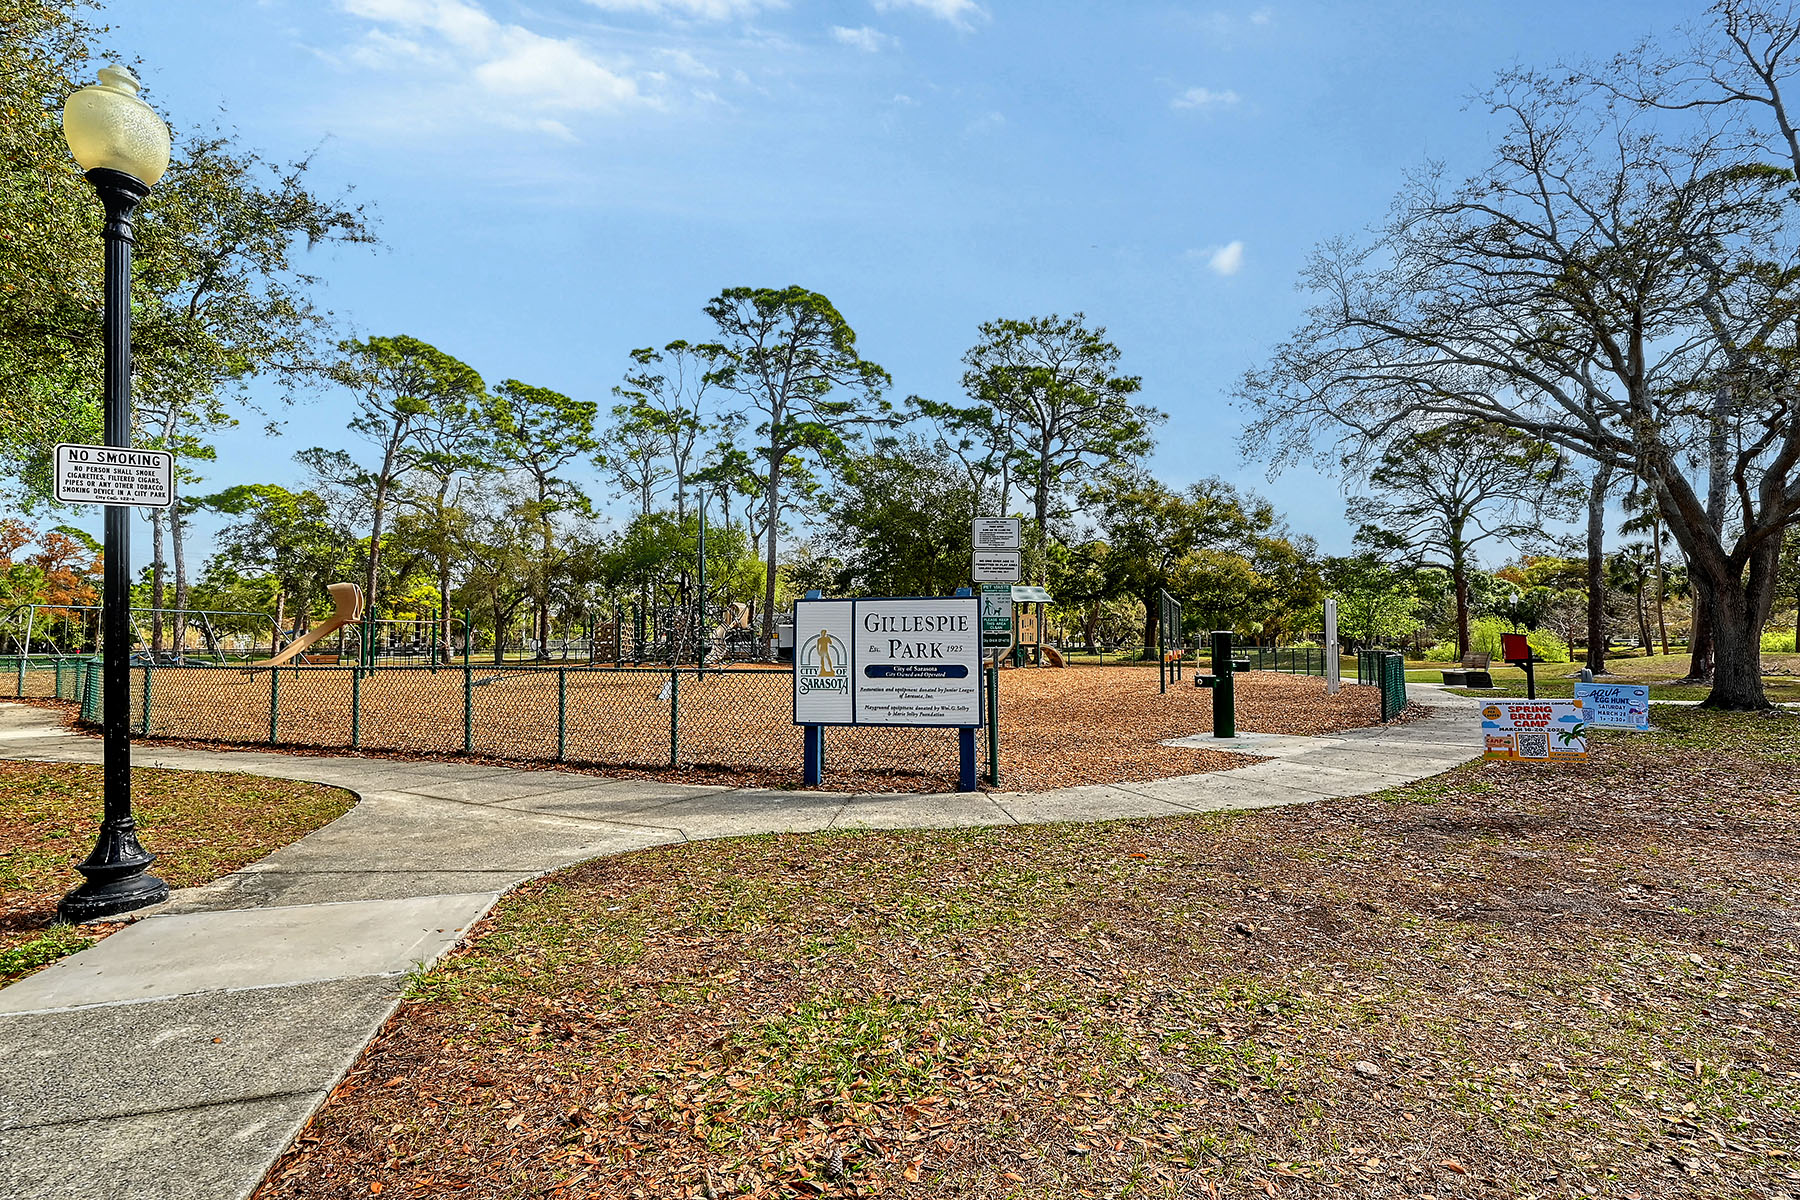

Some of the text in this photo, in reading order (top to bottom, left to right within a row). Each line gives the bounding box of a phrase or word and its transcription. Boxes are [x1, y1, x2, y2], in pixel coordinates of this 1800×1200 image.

[69, 449, 161, 466] NO SMOKING
[86, 466, 110, 474] PERSON
[67, 472, 106, 481] CIGARETTES,
[137, 476, 161, 484] CIGARS,
[62, 486, 90, 494] SMOKING
[864, 612, 969, 633] GILLESPIE
[888, 639, 944, 659] PARK
[946, 645, 963, 653] 1925
[799, 677, 849, 695] SARASOTA
[1589, 688, 1621, 697] AQUA
